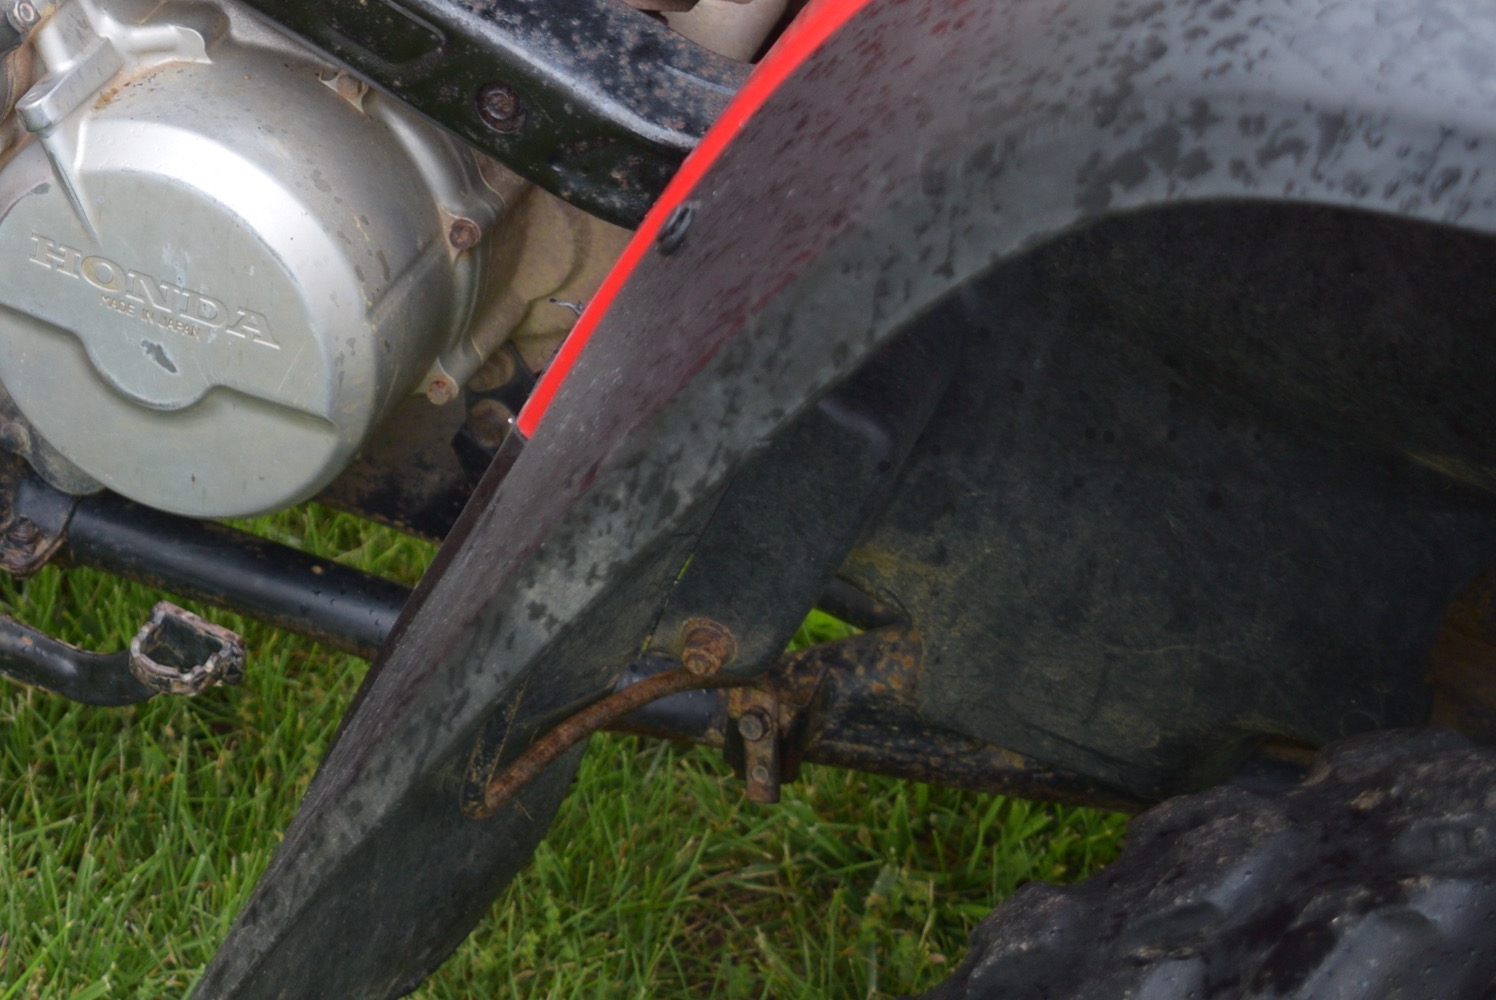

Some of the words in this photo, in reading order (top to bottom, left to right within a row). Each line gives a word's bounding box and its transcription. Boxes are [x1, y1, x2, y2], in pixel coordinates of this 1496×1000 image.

[29, 233, 281, 350] HONDA
[100, 294, 136, 318] MADE
[141, 309, 154, 325] IN
[158, 316, 201, 340] JAPAN
